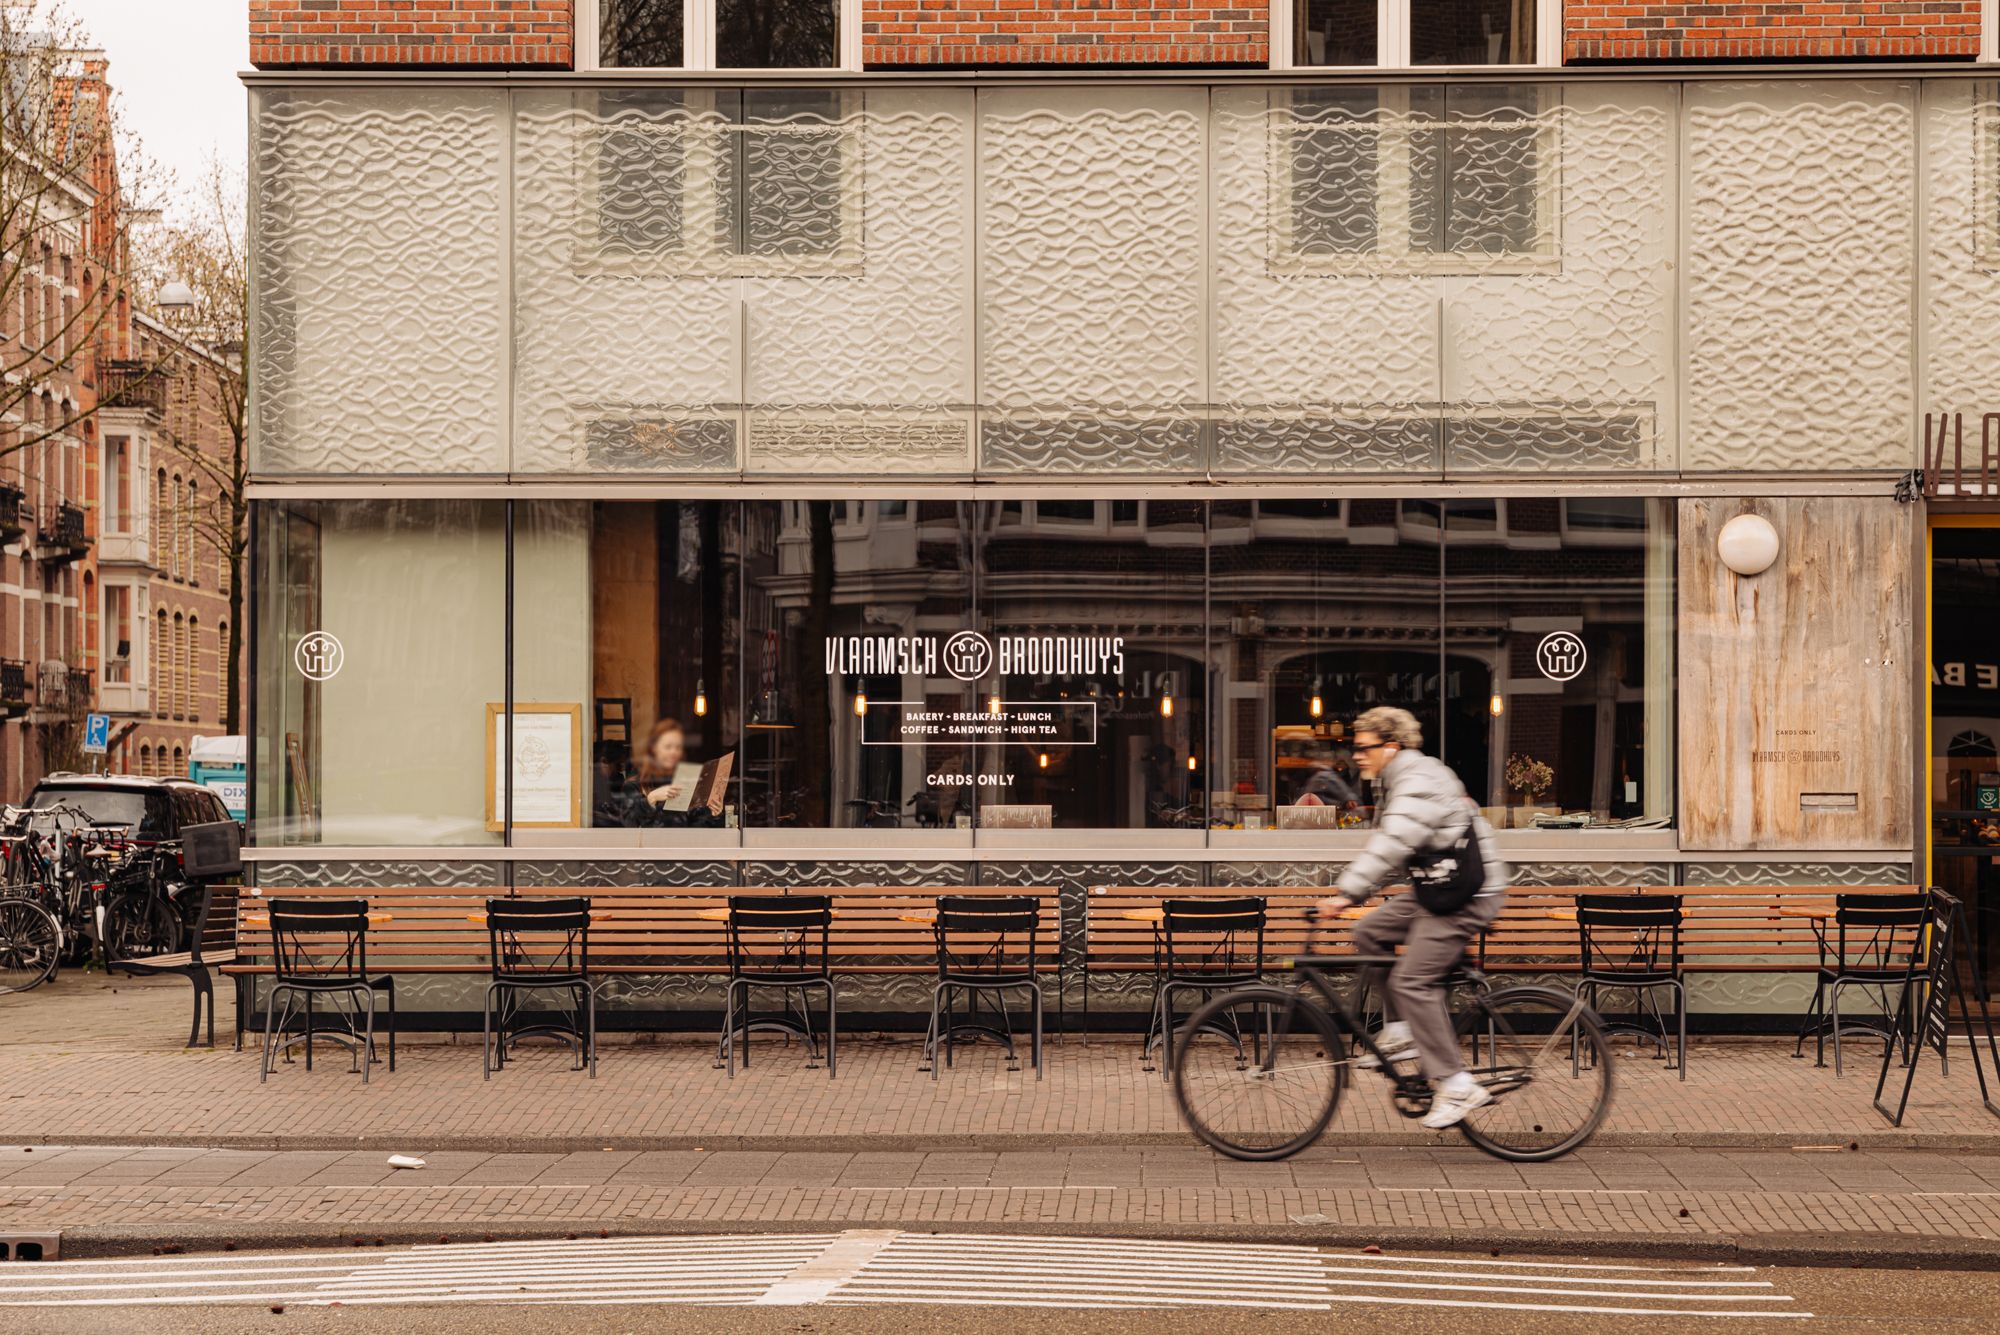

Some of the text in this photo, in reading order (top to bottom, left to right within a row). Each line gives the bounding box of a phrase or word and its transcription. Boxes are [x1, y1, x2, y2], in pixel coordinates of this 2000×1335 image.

[825, 637, 1124, 675] VLAAMSCH BROODHUYS
[906, 712, 1052, 721] BAKERY BREAKFAST LUNCH
[91, 717, 105, 734] P
[900, 725, 1057, 734] COFFEE SANDWICH HIGH TEA
[926, 774, 1015, 786] CARDS ONLY
